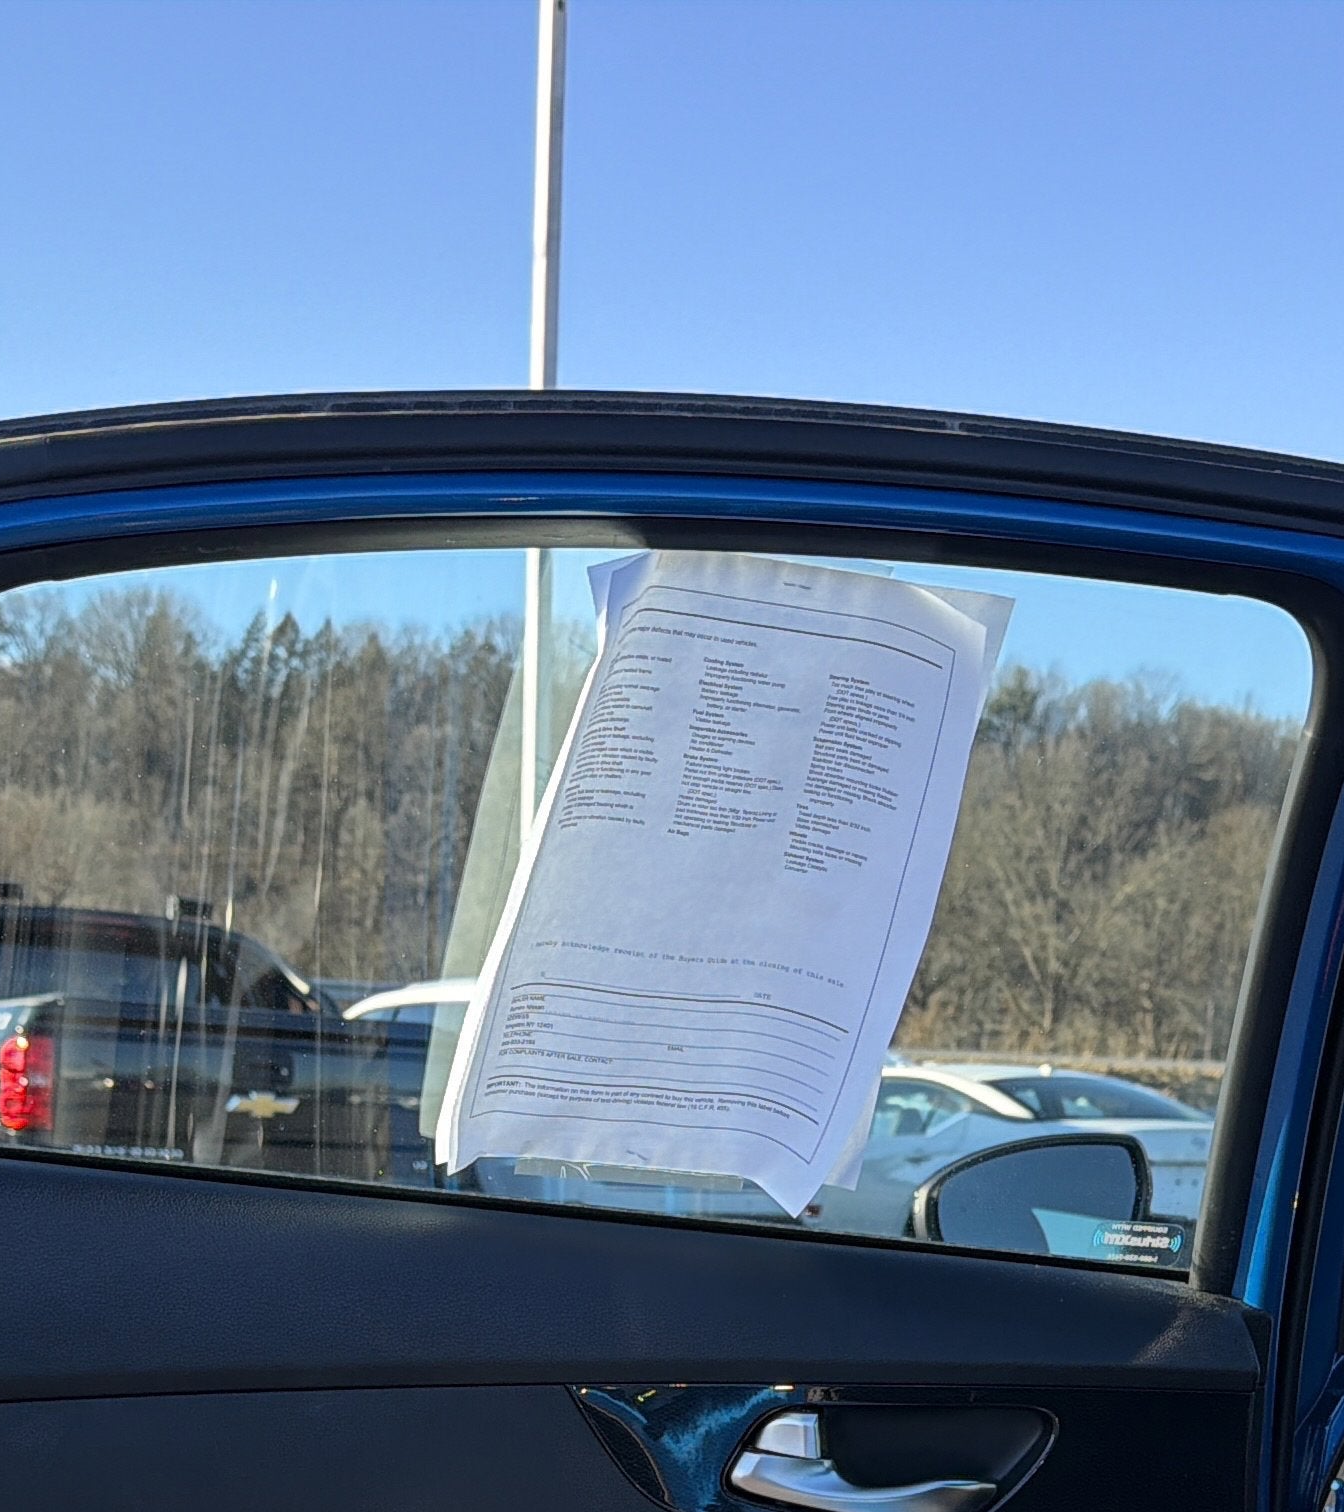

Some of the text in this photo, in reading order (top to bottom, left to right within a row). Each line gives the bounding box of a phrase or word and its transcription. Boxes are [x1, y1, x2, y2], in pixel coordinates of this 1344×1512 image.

[561, 941, 610, 953] acknowledge
[679, 955, 704, 964] Buyers
[758, 961, 789, 973] closing
[793, 967, 803, 975] of
[807, 970, 824, 980] this
[524, 1081, 535, 1089] The
